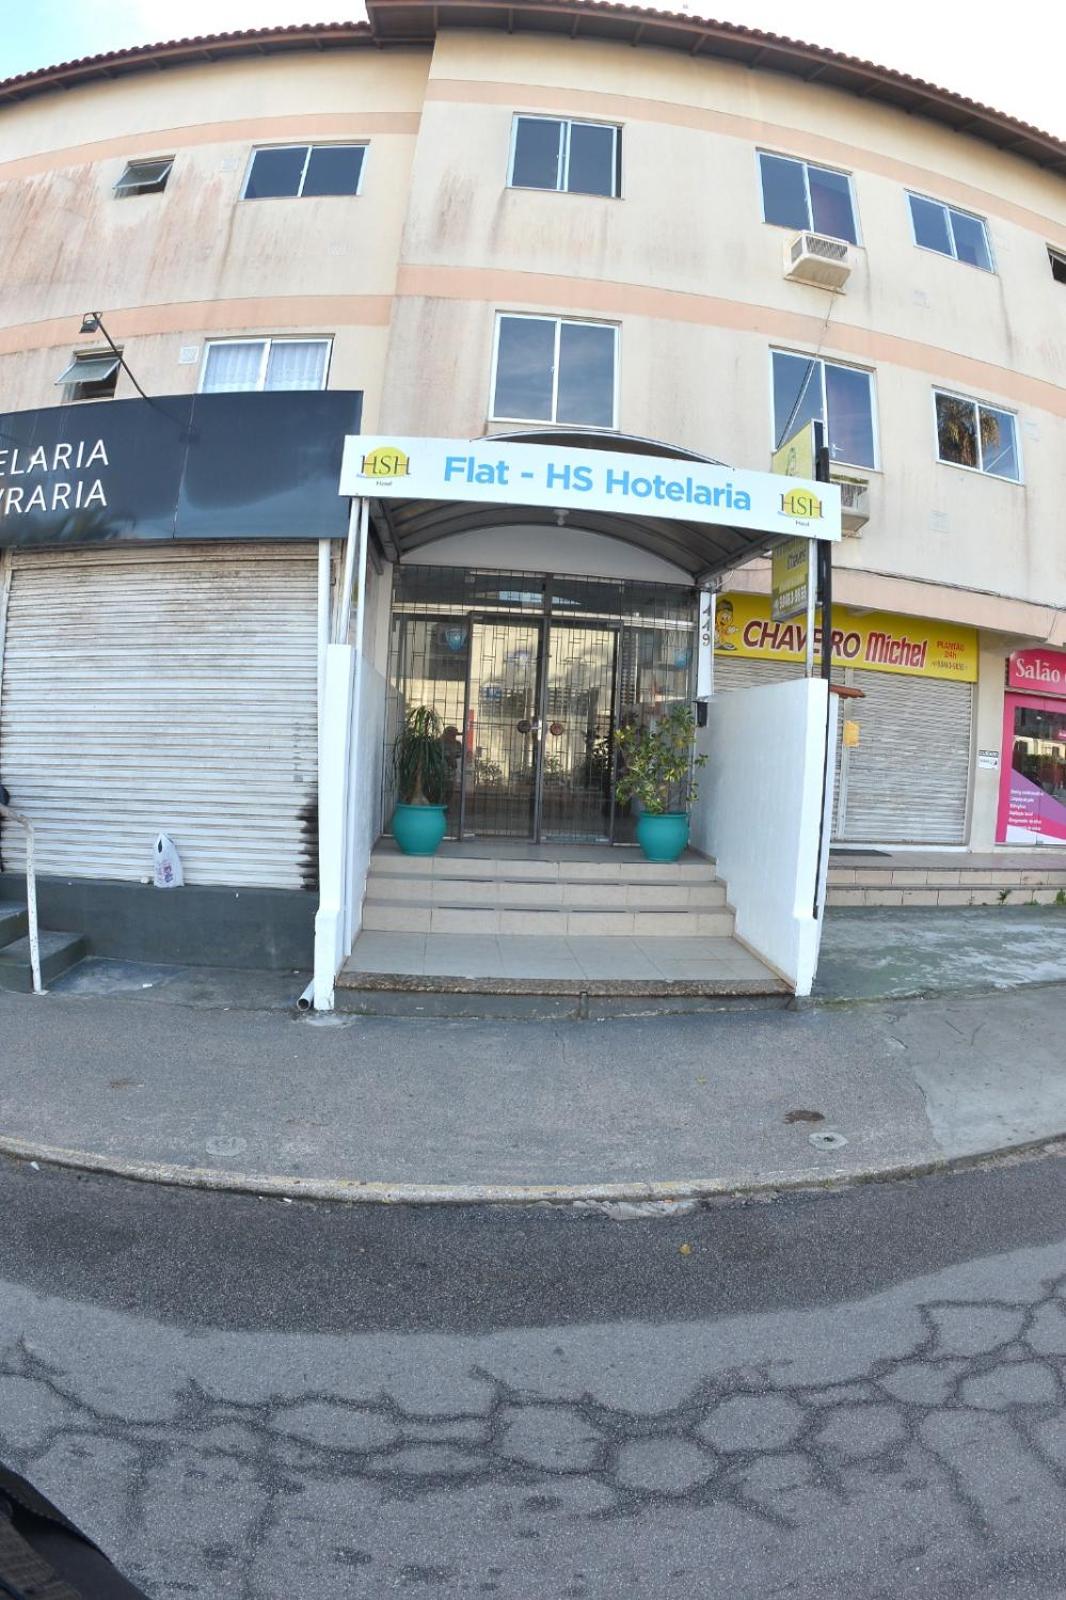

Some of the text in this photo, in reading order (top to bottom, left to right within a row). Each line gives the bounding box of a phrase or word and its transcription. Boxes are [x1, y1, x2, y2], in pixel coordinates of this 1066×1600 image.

[443, 456, 510, 485] Flat
[545, 463, 594, 492] HS
[606, 469, 752, 511] Hotelaria
[743, 620, 928, 669] CHAVERO Michel
[1015, 658, 1061, 683] Salão
